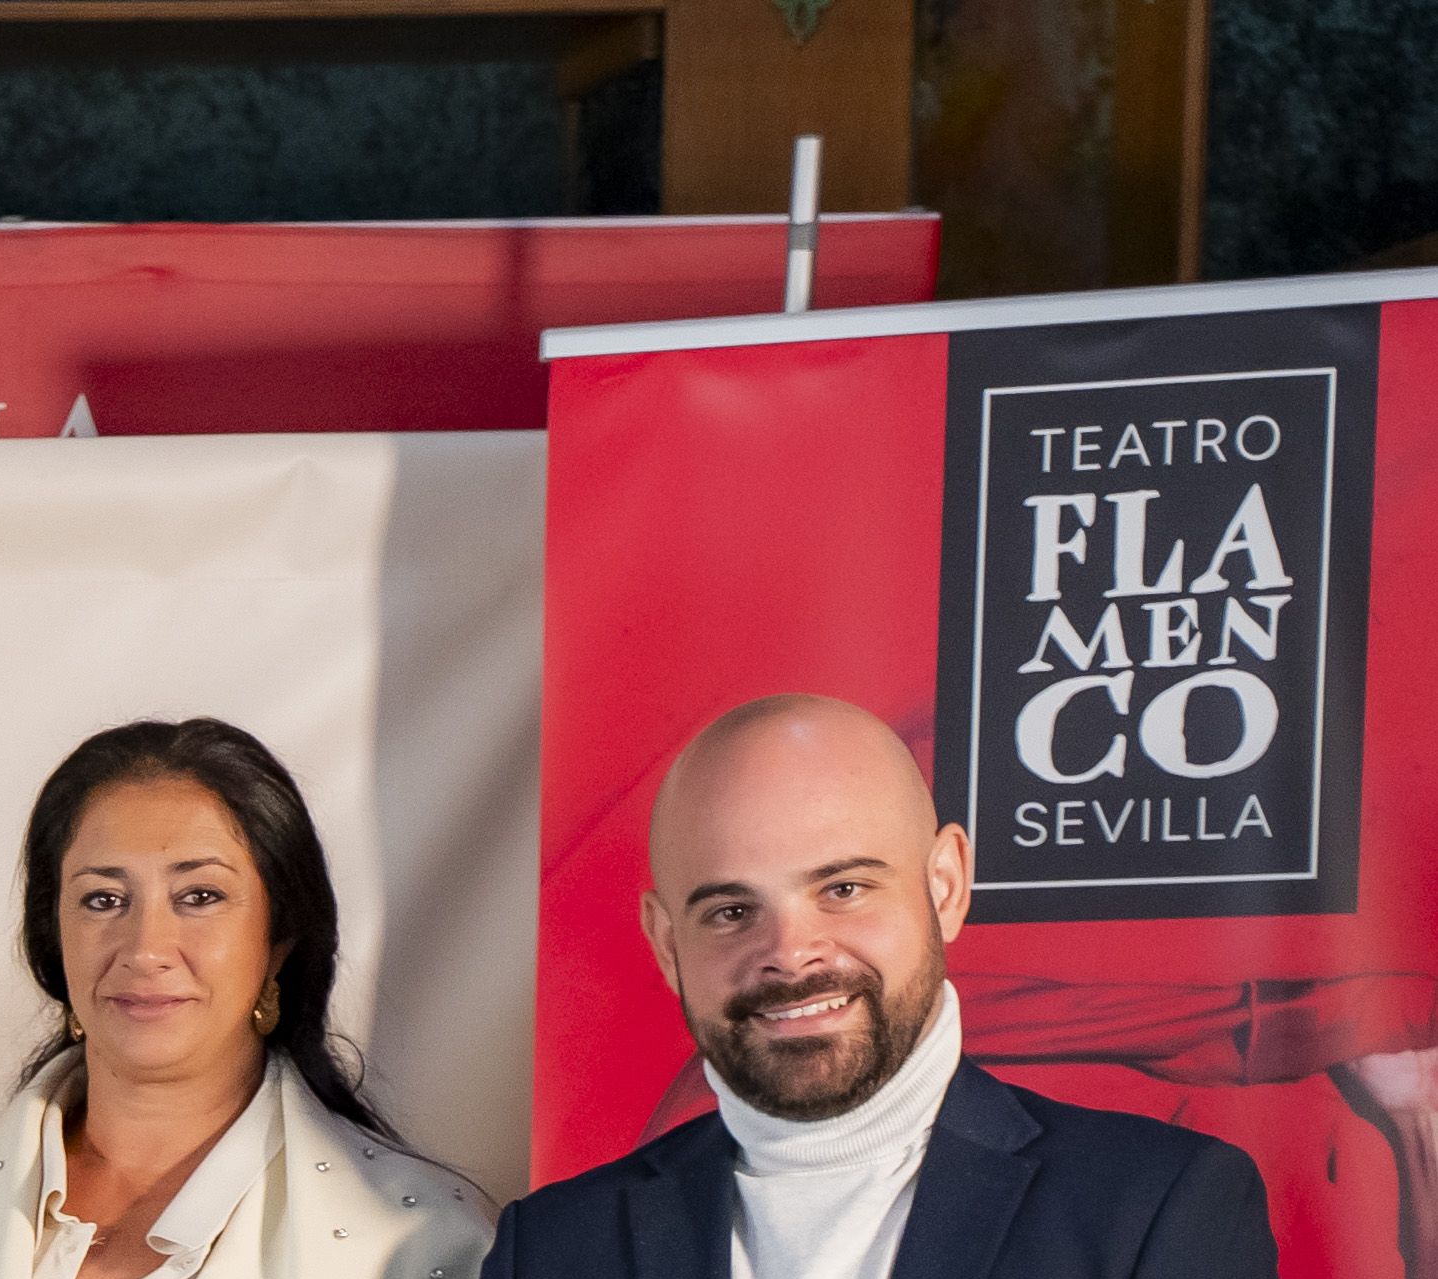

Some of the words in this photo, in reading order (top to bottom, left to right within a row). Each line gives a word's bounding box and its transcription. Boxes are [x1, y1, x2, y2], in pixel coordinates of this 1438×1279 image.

[1029, 414, 1282, 473] TEATRO
[1023, 482, 1294, 602] FLA
[1017, 593, 1293, 675] MEN
[1014, 668, 1279, 785] CO
[1012, 794, 1274, 850] SEVILLA
